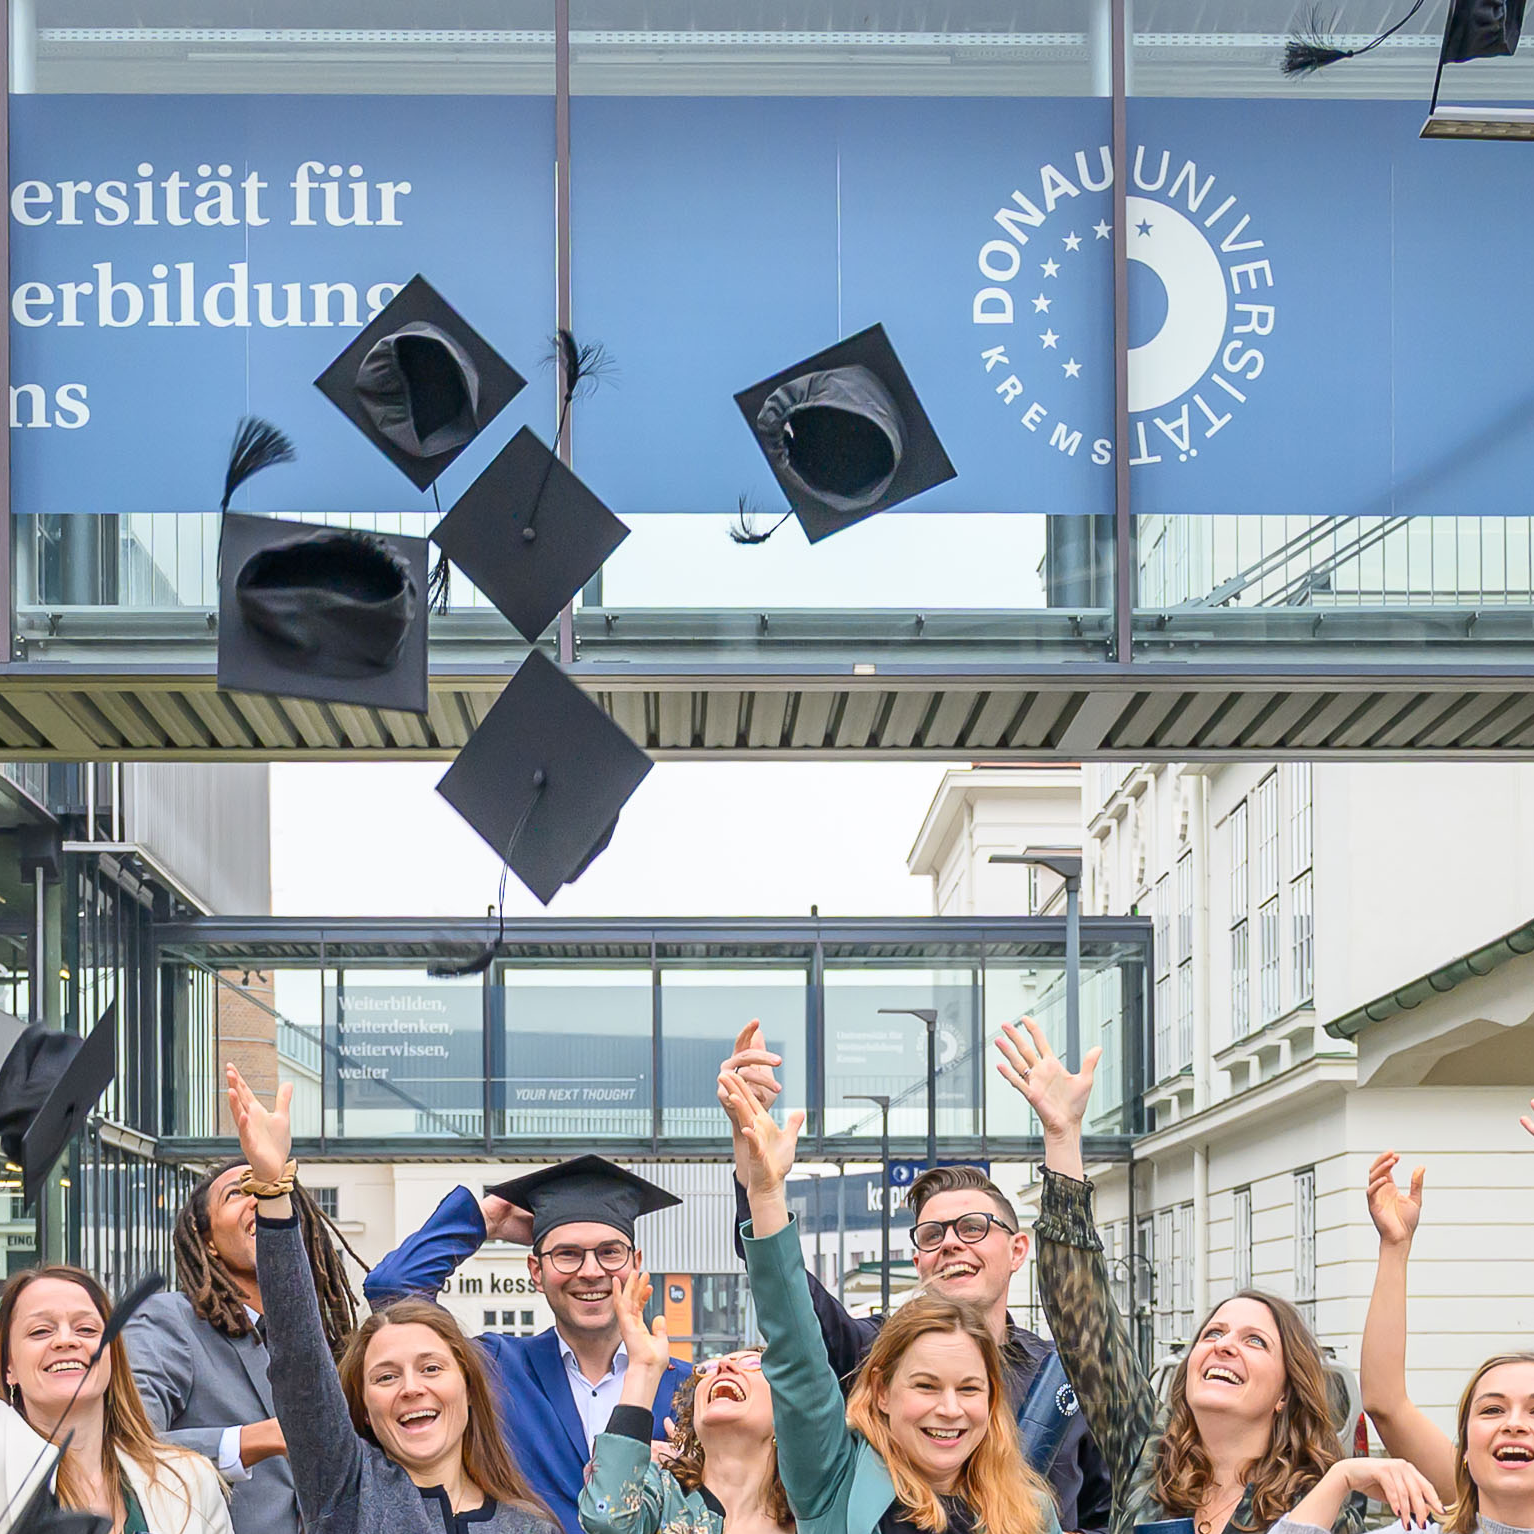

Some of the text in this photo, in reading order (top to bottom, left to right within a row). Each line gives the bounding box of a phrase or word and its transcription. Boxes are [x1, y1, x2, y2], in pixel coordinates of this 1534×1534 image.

[290, 160, 412, 226] für
[973, 145, 1276, 466] DONAU UNIVERSITÄT
[981, 344, 1113, 466] KREMS
[338, 996, 448, 1014] Weiterbilden,
[338, 1019, 454, 1035] weiterdenken,
[338, 1041, 450, 1059] weiterwissen,
[338, 1064, 389, 1080] weiter
[516, 1088, 636, 1101] YOUR NEXT THOUGHT
[459, 1272, 483, 1294] im
[490, 1272, 537, 1294] kess
